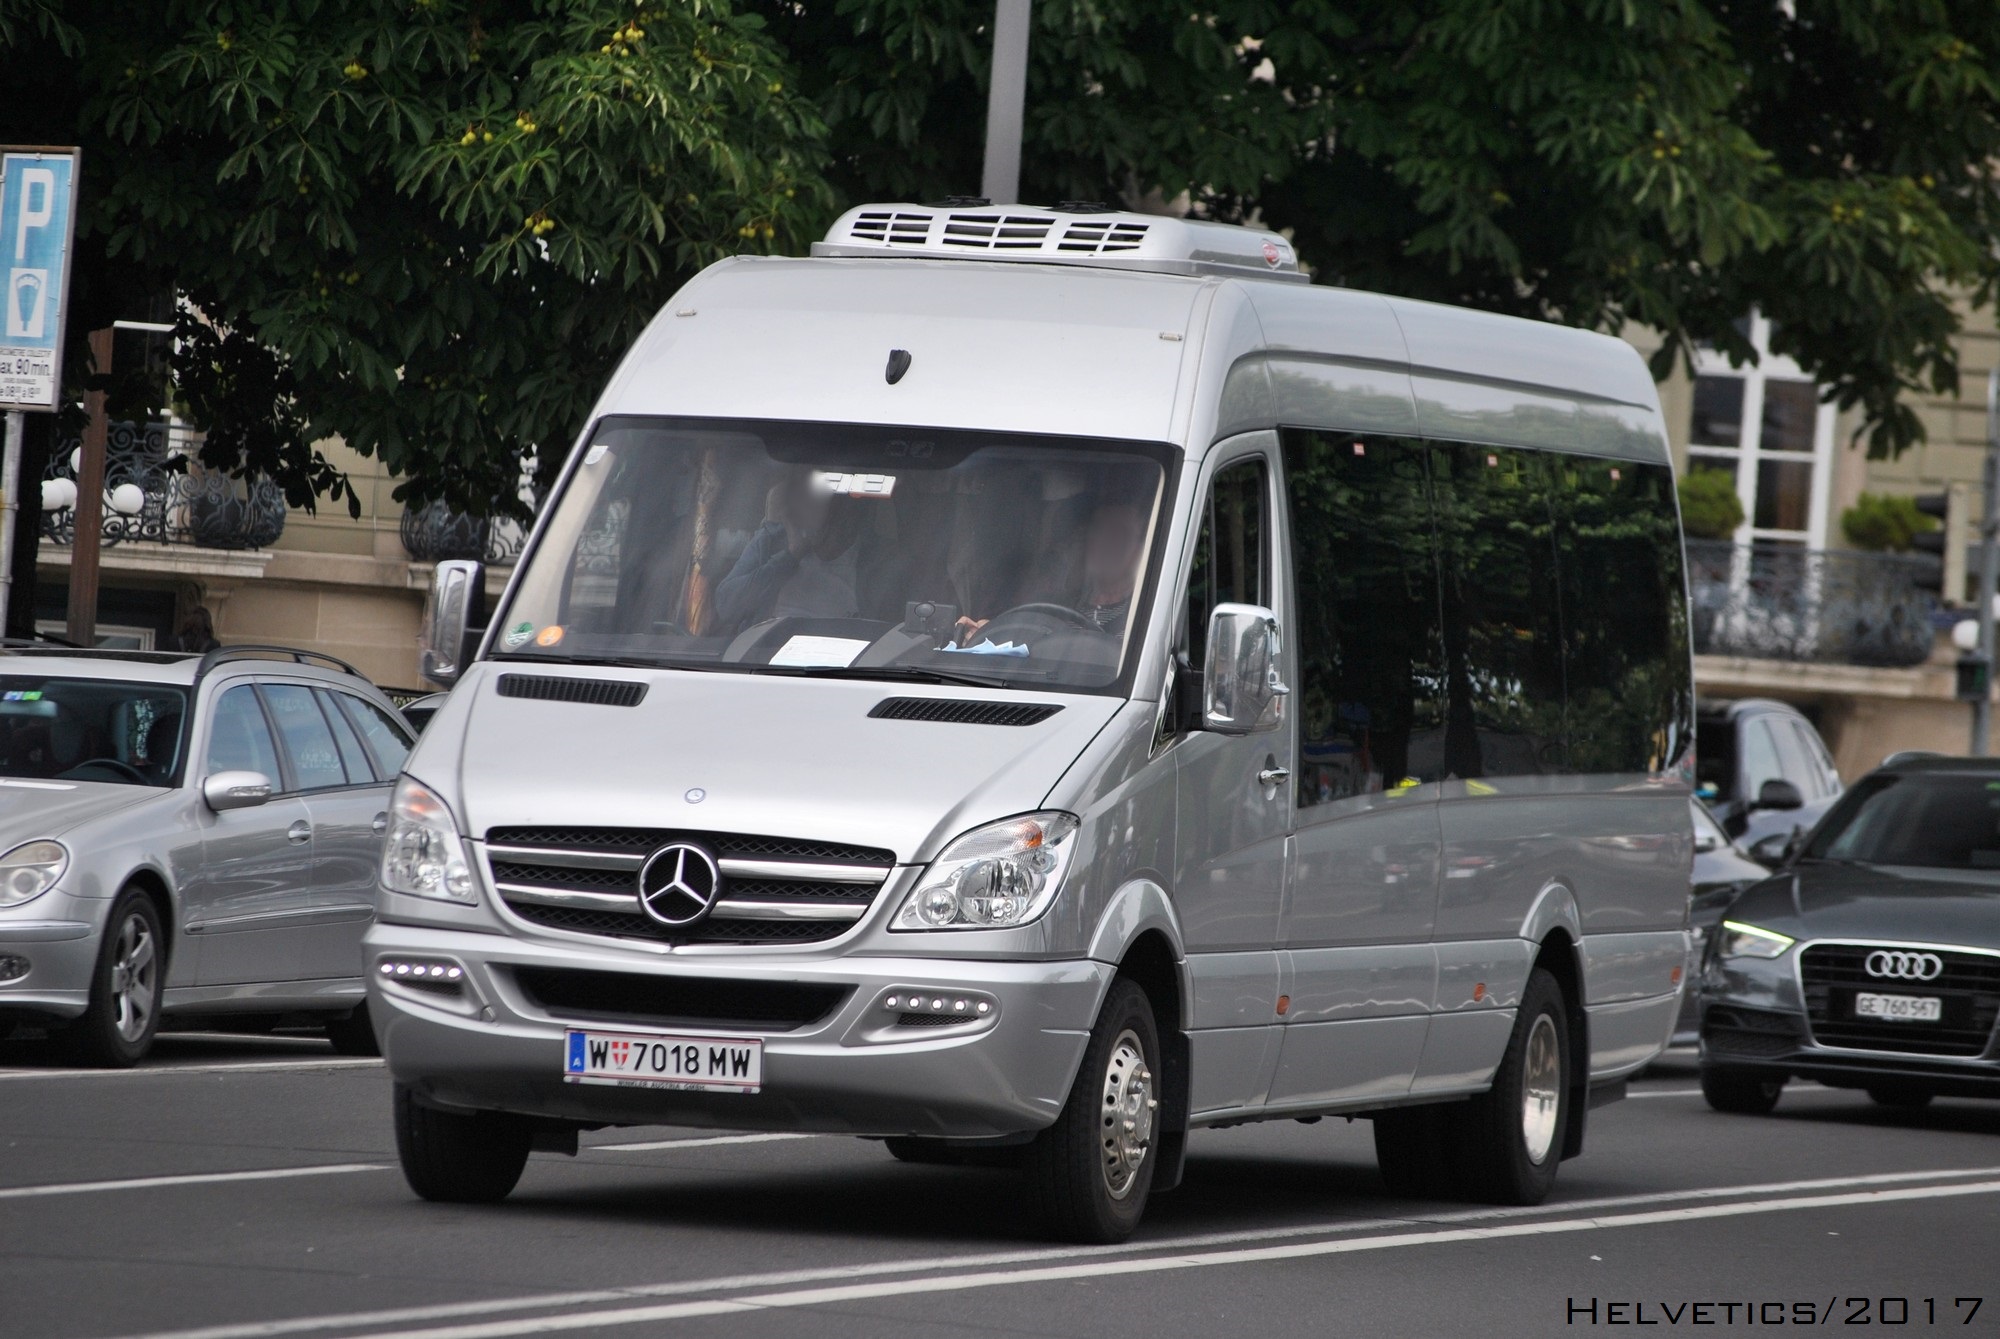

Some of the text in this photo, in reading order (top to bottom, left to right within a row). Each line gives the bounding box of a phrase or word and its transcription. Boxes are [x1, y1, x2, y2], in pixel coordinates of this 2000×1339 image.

[15, 168, 54, 260] P
[0, 361, 13, 375] ax.
[16, 358, 30, 375] 90
[1860, 996, 1878, 1014] GE
[589, 1039, 751, 1078] W 7018 MW
